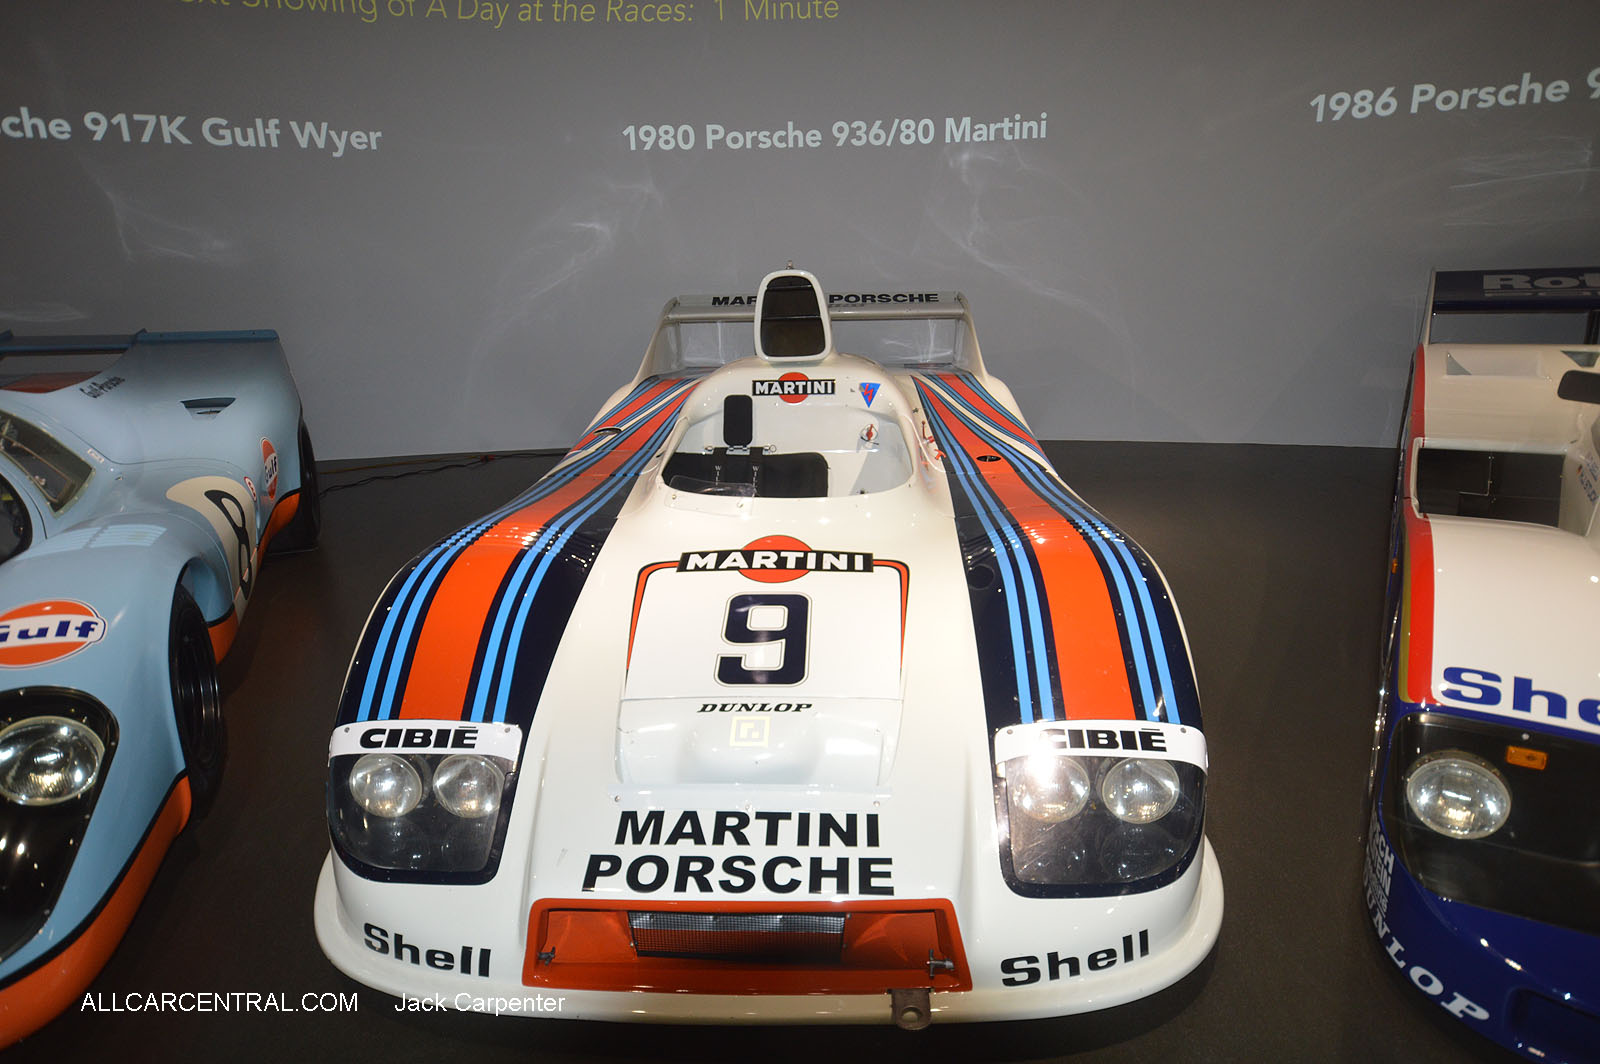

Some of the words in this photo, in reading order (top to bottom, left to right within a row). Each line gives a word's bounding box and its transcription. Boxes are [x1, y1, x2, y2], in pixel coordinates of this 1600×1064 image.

[425, 0, 448, 19] A
[457, 0, 508, 28] Day
[518, 3, 543, 22] at
[552, 0, 597, 22] the
[606, 0, 694, 22] Races:
[744, 0, 840, 21] Minute
[1310, 86, 1398, 123] 1986
[1410, 72, 1571, 114] Porsche
[0, 106, 72, 140] che
[83, 111, 192, 145] 917K
[201, 117, 281, 148] Gulf
[289, 121, 382, 158] Wyer
[622, 124, 696, 151] 1980
[706, 121, 822, 149] Porsche
[832, 118, 935, 147] 936/80
[944, 112, 1048, 144] Martini
[829, 294, 939, 304] PORSCHE
[755, 381, 833, 395] MARTINI
[685, 550, 865, 571] MARTINI
[716, 593, 810, 686] 9
[696, 702, 813, 713] DUNLOP
[615, 810, 880, 848] MARTINI
[582, 854, 895, 896] PORSCHE
[364, 923, 491, 978] Shell
[1000, 929, 1149, 987] Shell
